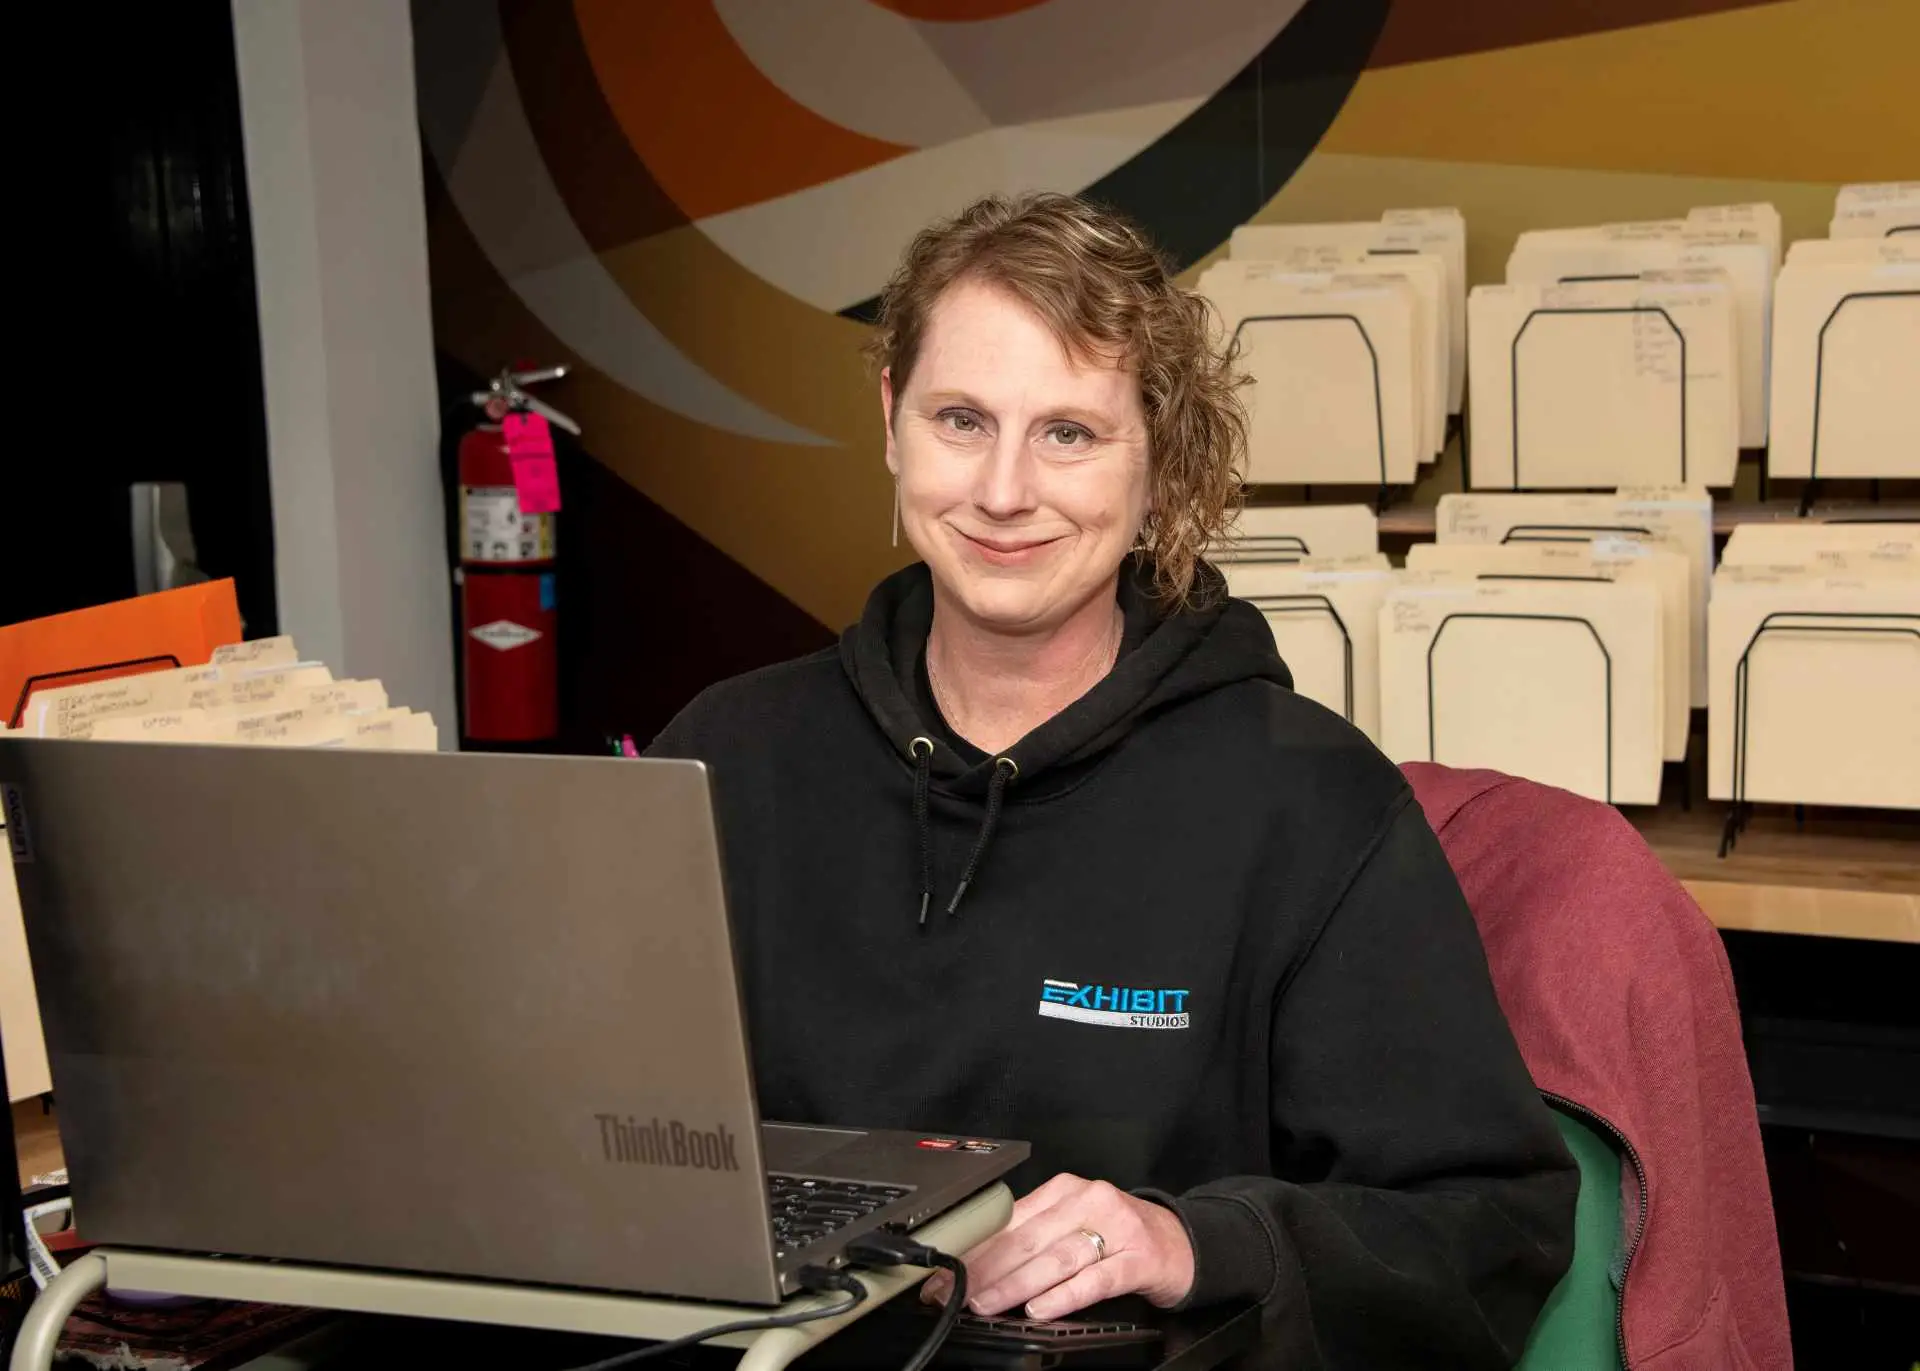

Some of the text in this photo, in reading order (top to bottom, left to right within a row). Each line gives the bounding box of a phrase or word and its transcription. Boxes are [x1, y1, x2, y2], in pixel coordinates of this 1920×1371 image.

[1042, 980, 1190, 1013] EXHIBIT
[1130, 1014, 1188, 1028] STUDIOS
[594, 1113, 740, 1172] ThinkBook
